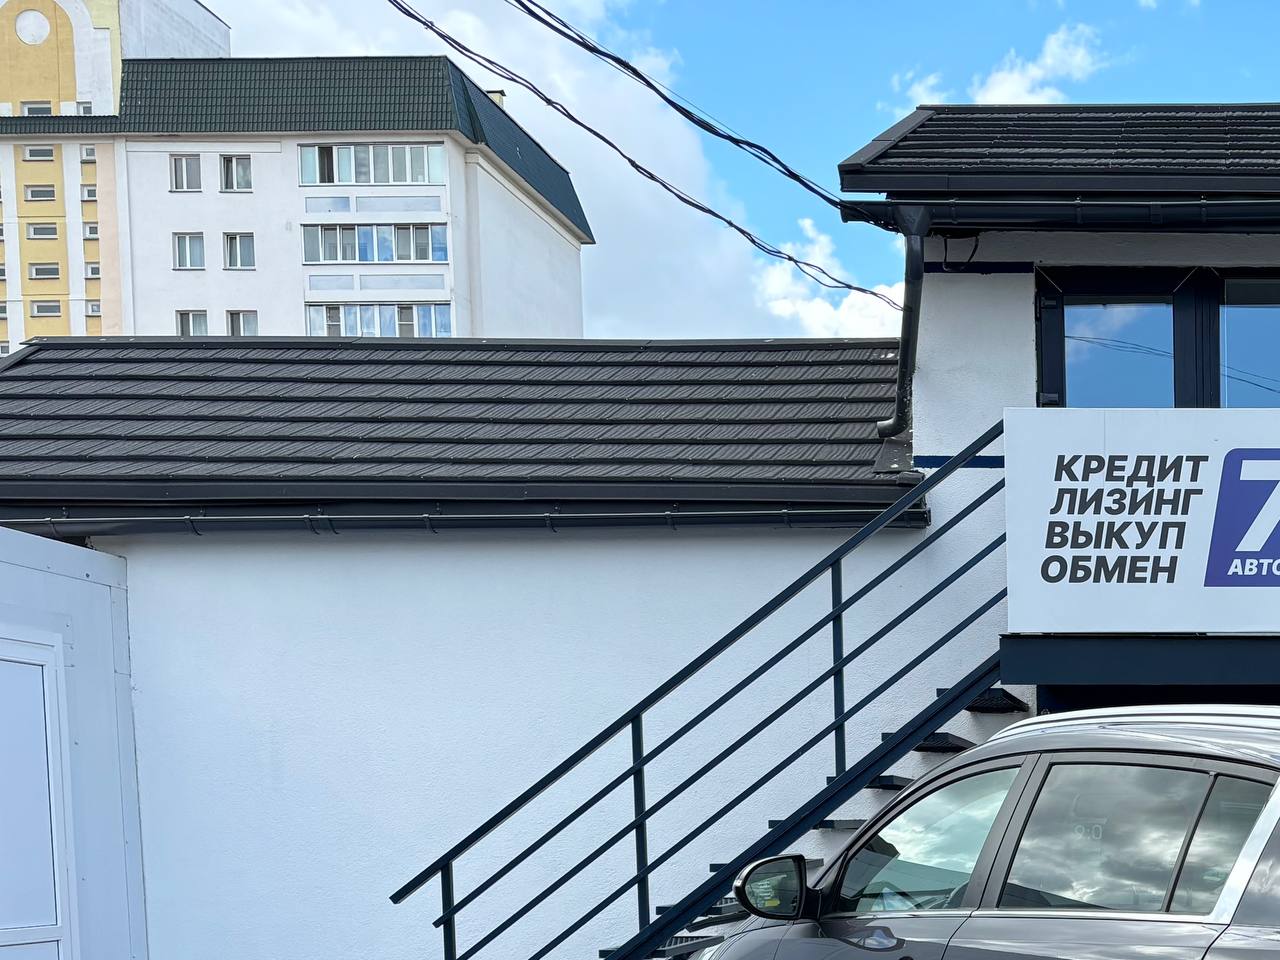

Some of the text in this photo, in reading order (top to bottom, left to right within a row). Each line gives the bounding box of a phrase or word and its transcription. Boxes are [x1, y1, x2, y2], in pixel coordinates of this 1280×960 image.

[1054, 455, 1208, 487] КРЕДИТ
[1049, 488, 1204, 516] ЛИЗИНГ
[1045, 521, 1186, 549] ВЫКУП
[1040, 555, 1177, 584] ОБМЕН
